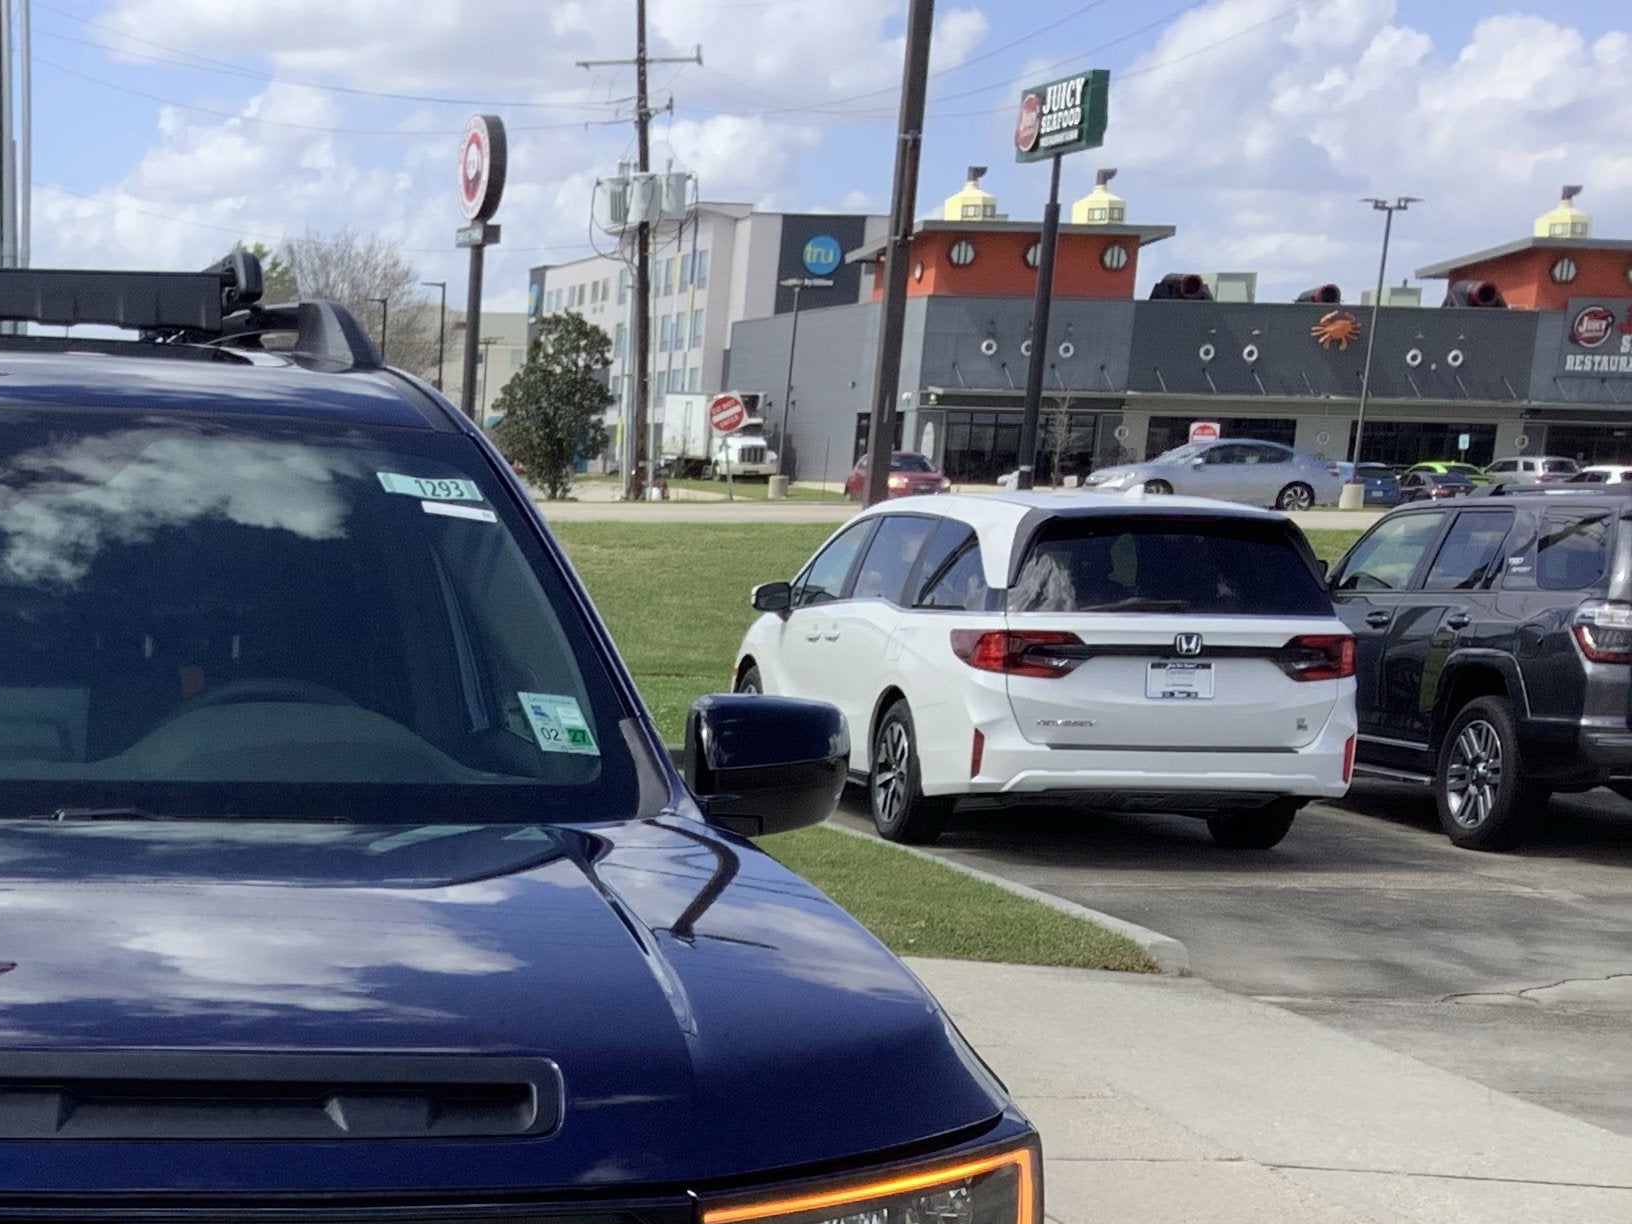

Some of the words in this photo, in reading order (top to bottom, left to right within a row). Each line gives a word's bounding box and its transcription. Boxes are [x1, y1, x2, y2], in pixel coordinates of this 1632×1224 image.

[1042, 77, 1085, 114] JUICY
[1041, 107, 1082, 134] SEAFOOD
[805, 243, 834, 263] tru
[1565, 354, 1632, 372] RESTAUR
[414, 480, 465, 497] 1293
[540, 726, 562, 742] 02
